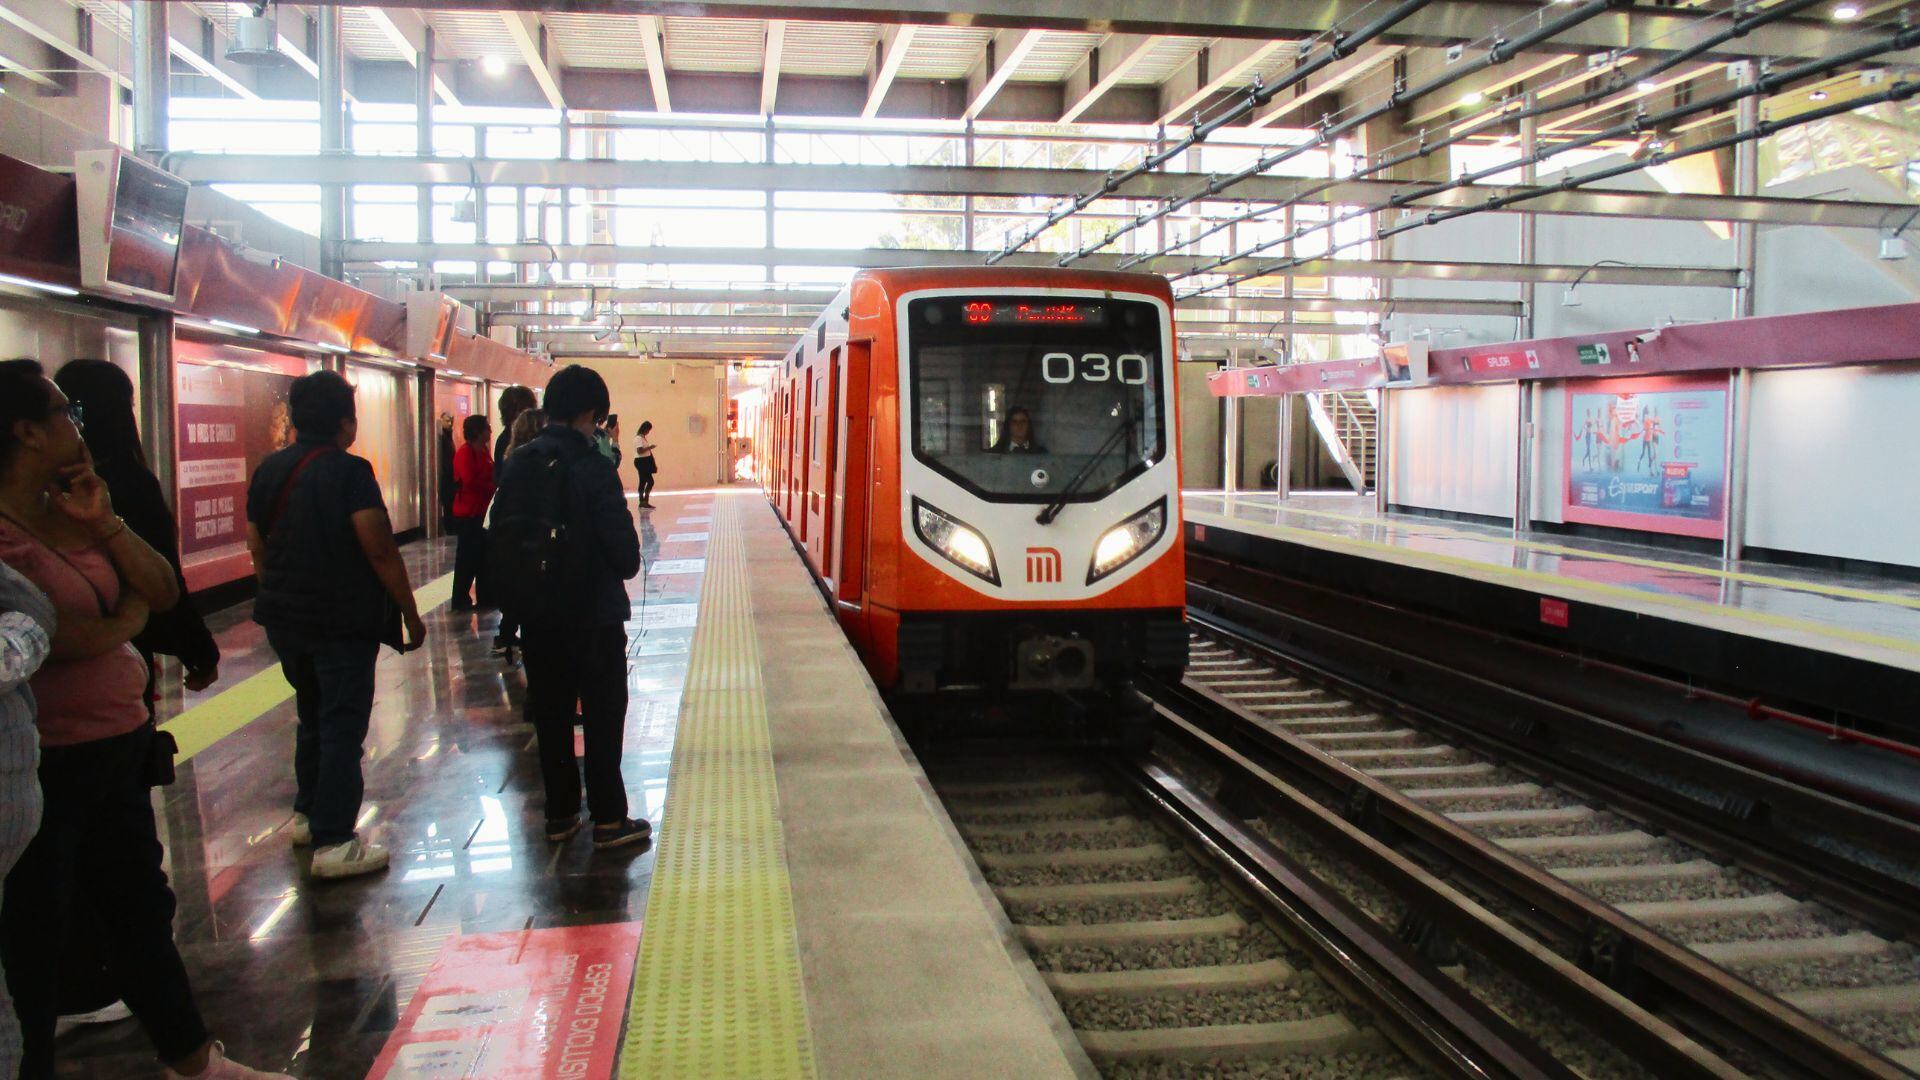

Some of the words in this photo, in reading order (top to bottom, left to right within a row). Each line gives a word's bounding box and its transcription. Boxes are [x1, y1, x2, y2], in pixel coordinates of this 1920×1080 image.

[1042, 353, 1148, 385] 030
[1488, 356, 1511, 367] SALIDA
[575, 962, 612, 1016] ESPACIO
